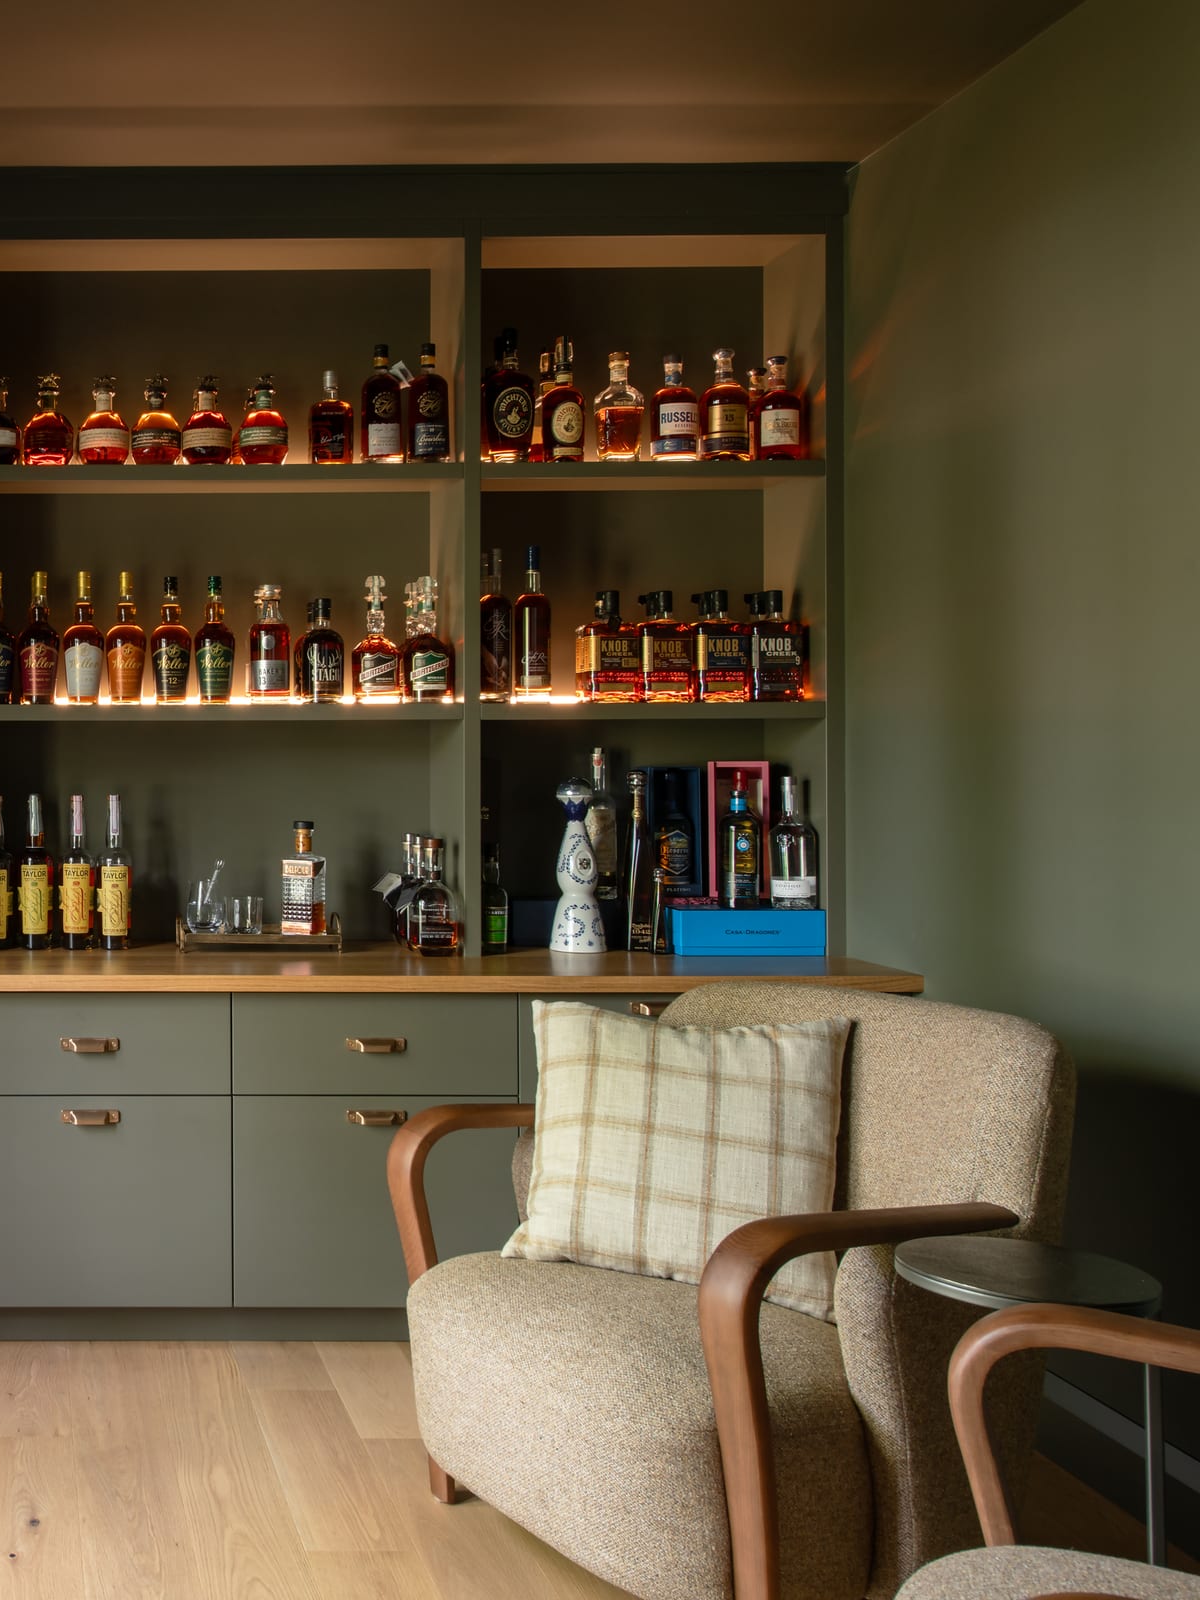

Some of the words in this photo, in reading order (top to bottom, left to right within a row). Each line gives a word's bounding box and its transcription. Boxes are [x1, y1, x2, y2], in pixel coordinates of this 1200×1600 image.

[601, 639, 628, 652] KNOB
[654, 640, 682, 653] KNOB
[708, 638, 739, 652] KNOB
[760, 637, 792, 652] KNOB
[156, 653, 189, 669] Weller
[200, 653, 232, 669] Weller
[23, 870, 46, 878] TAYLOR
[103, 872, 127, 880] TAYLOR
